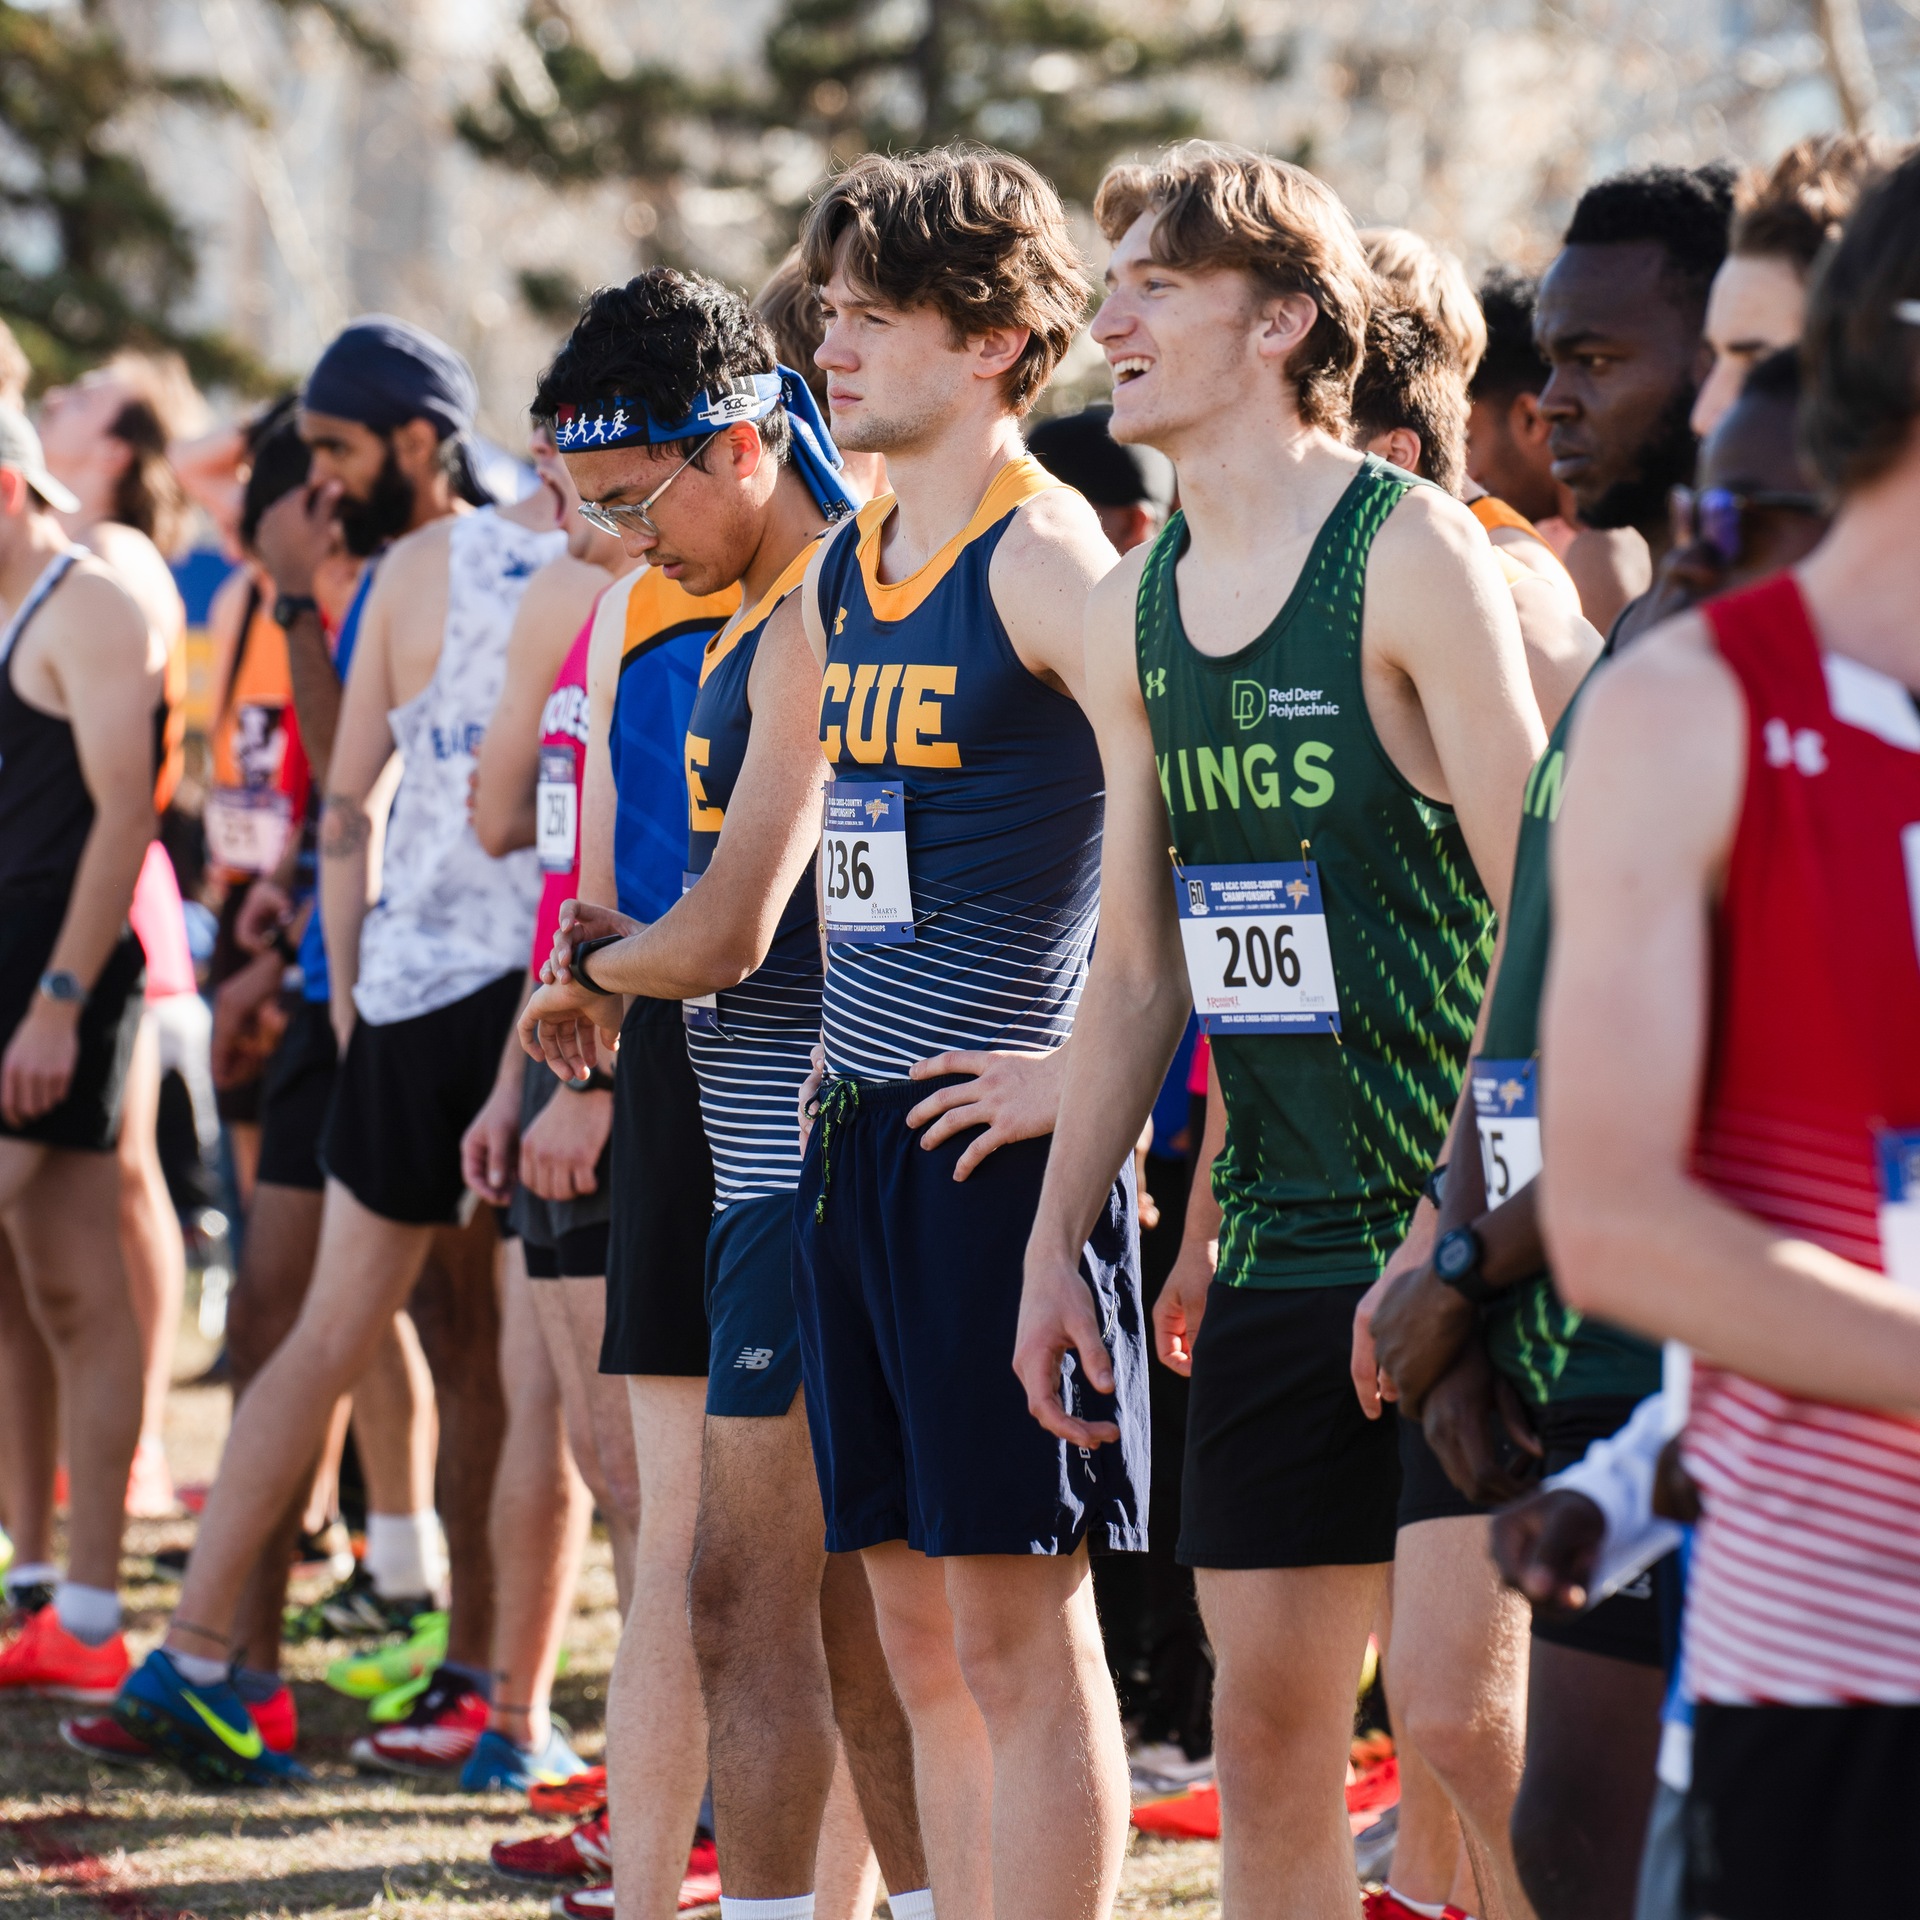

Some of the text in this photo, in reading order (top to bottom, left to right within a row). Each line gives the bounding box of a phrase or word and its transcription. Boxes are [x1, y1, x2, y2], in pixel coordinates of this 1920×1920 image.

[1269, 687, 1323, 702] Red Deer
[819, 663, 962, 768] CUE
[1268, 701, 1339, 720] Polytechnic
[827, 839, 874, 901] 236
[1240, 880, 1283, 890] CROSS-COUNTRY
[1222, 890, 1276, 903] CHAMPIONSHIPS
[1216, 925, 1301, 988] 206
[1280, 1013, 1316, 1022] CHAMPIONSHIPS
